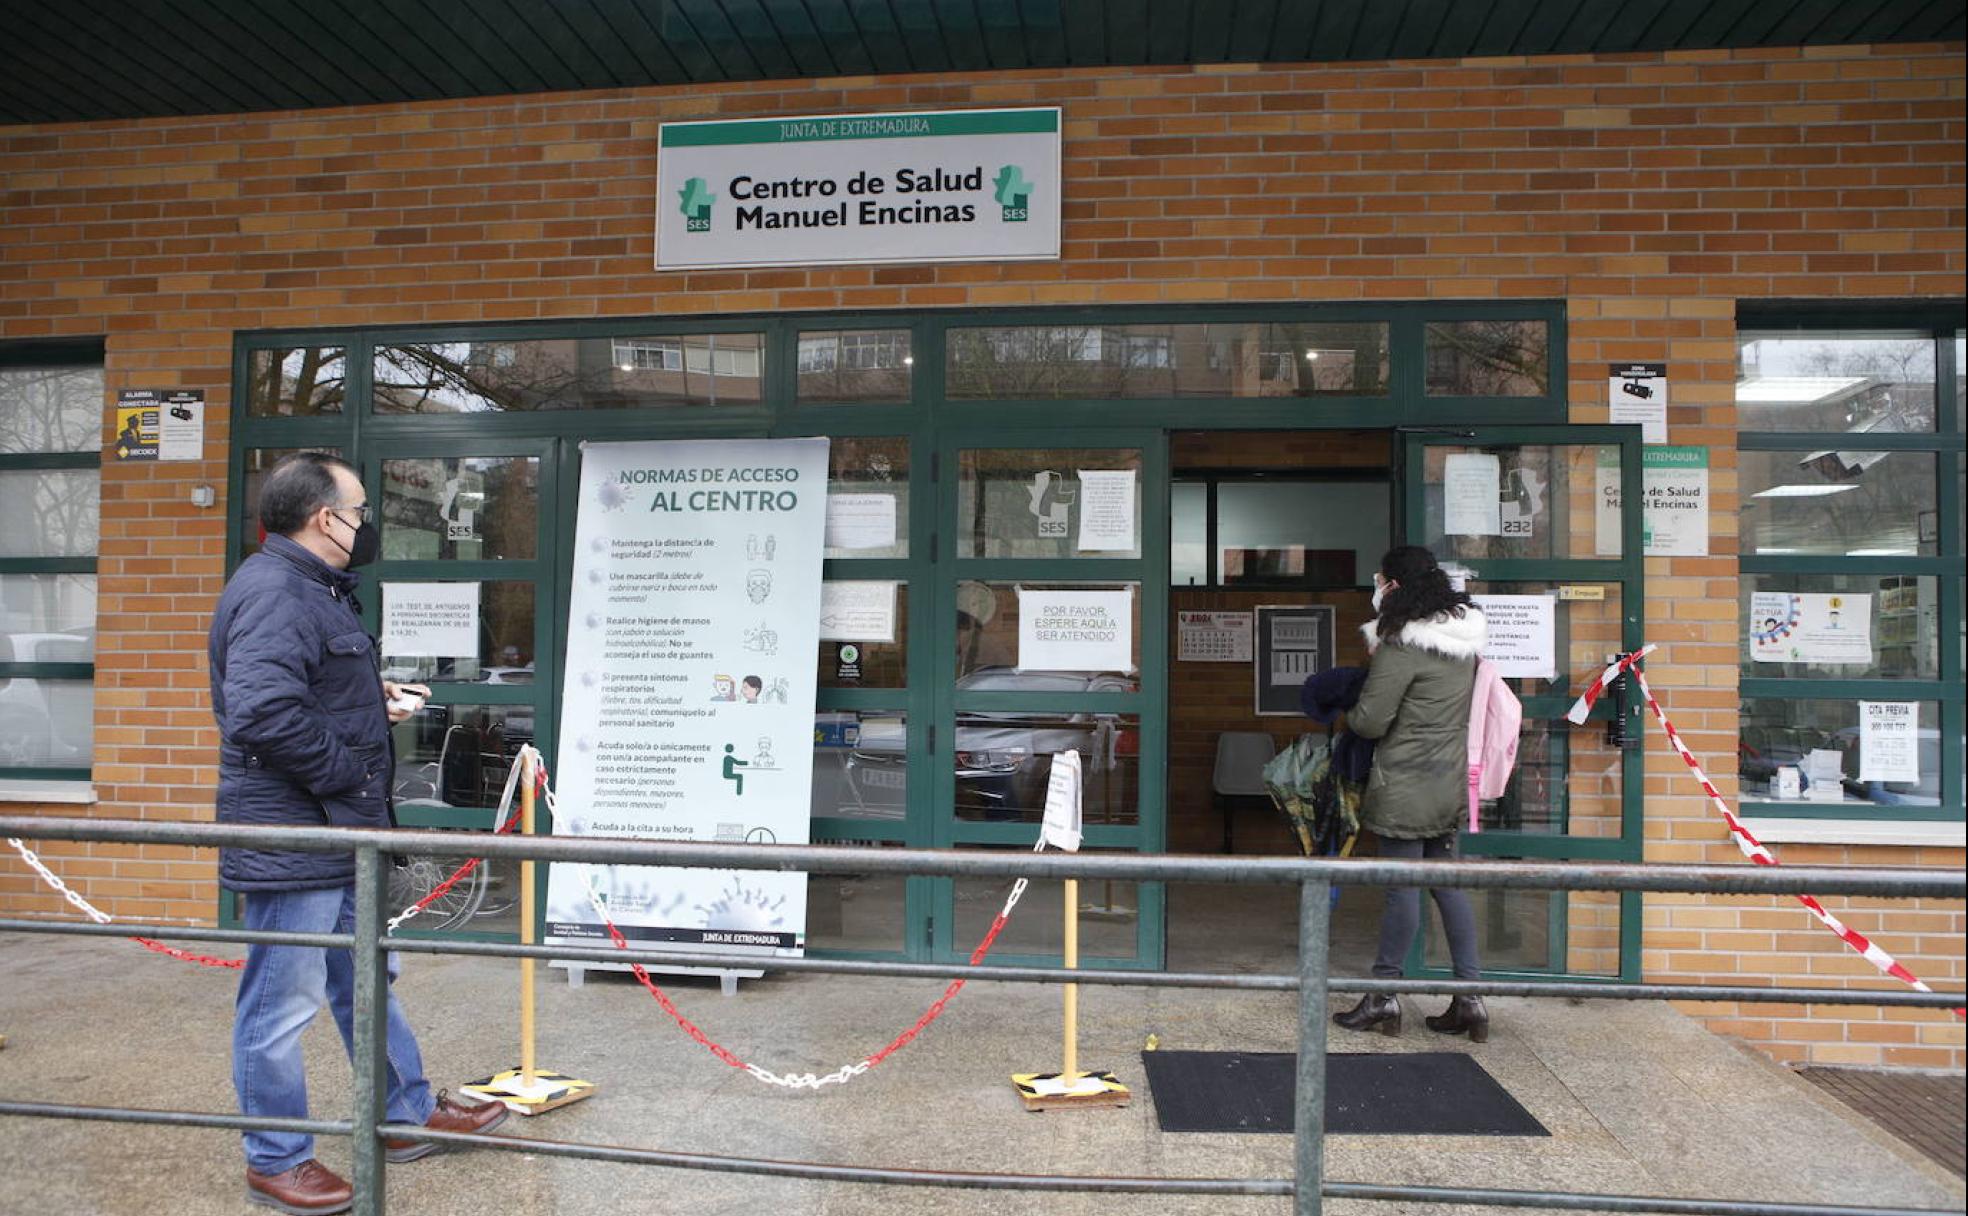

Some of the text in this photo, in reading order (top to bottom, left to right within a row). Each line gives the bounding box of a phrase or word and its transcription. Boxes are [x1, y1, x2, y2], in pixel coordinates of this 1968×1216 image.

[780, 118, 930, 139] JUNTA DE EXTREMADURA
[729, 166, 983, 201] Centro de Salud
[735, 198, 976, 231] Manuel Encinas
[1003, 208, 1027, 220] SES
[686, 218, 710, 231] SES
[620, 468, 799, 484] NORMAS DE ACCESO
[1650, 486, 1663, 497] de
[1667, 486, 1700, 497] Salud
[650, 491, 798, 512] AL CENTRO
[1653, 498, 1698, 509] Encinas
[449, 525, 471, 537] SES
[1040, 522, 1066, 533] SES
[611, 539, 714, 549] Mantenga la distancia de
[611, 549, 652, 560] seguridad
[609, 572, 625, 580] Use
[627, 572, 669, 580] mascarilla
[1043, 605, 1066, 617] POR
[606, 617, 637, 625] Realice
[638, 617, 669, 627] higiene
[670, 617, 680, 625] de
[1035, 617, 1077, 629] ESPERE
[1108, 618, 1116, 629] A
[1036, 630, 1115, 641] SER ATENDIDO
[669, 639, 682, 647] No
[604, 651, 641, 661] aconseja
[642, 651, 650, 659] el
[669, 651, 679, 659] de
[680, 651, 714, 662] guantes
[611, 674, 648, 683] presenta
[601, 685, 655, 694] respiratorios
[708, 708, 716, 716] al
[1869, 704, 1910, 715] CITA PREVIA
[599, 719, 675, 729] personal sanitario
[597, 741, 624, 750] Acuda
[625, 742, 651, 751] solo/a
[596, 754, 612, 762] con
[613, 754, 632, 762] un/a
[616, 766, 676, 775] estrictamente
[594, 776, 636, 785] necesario
[591, 822, 619, 831] Acuda
[627, 823, 636, 831] la
[637, 823, 653, 831] cita
[673, 825, 694, 833] hora
[703, 932, 781, 945] JUNTA DE EXTREMADURA
